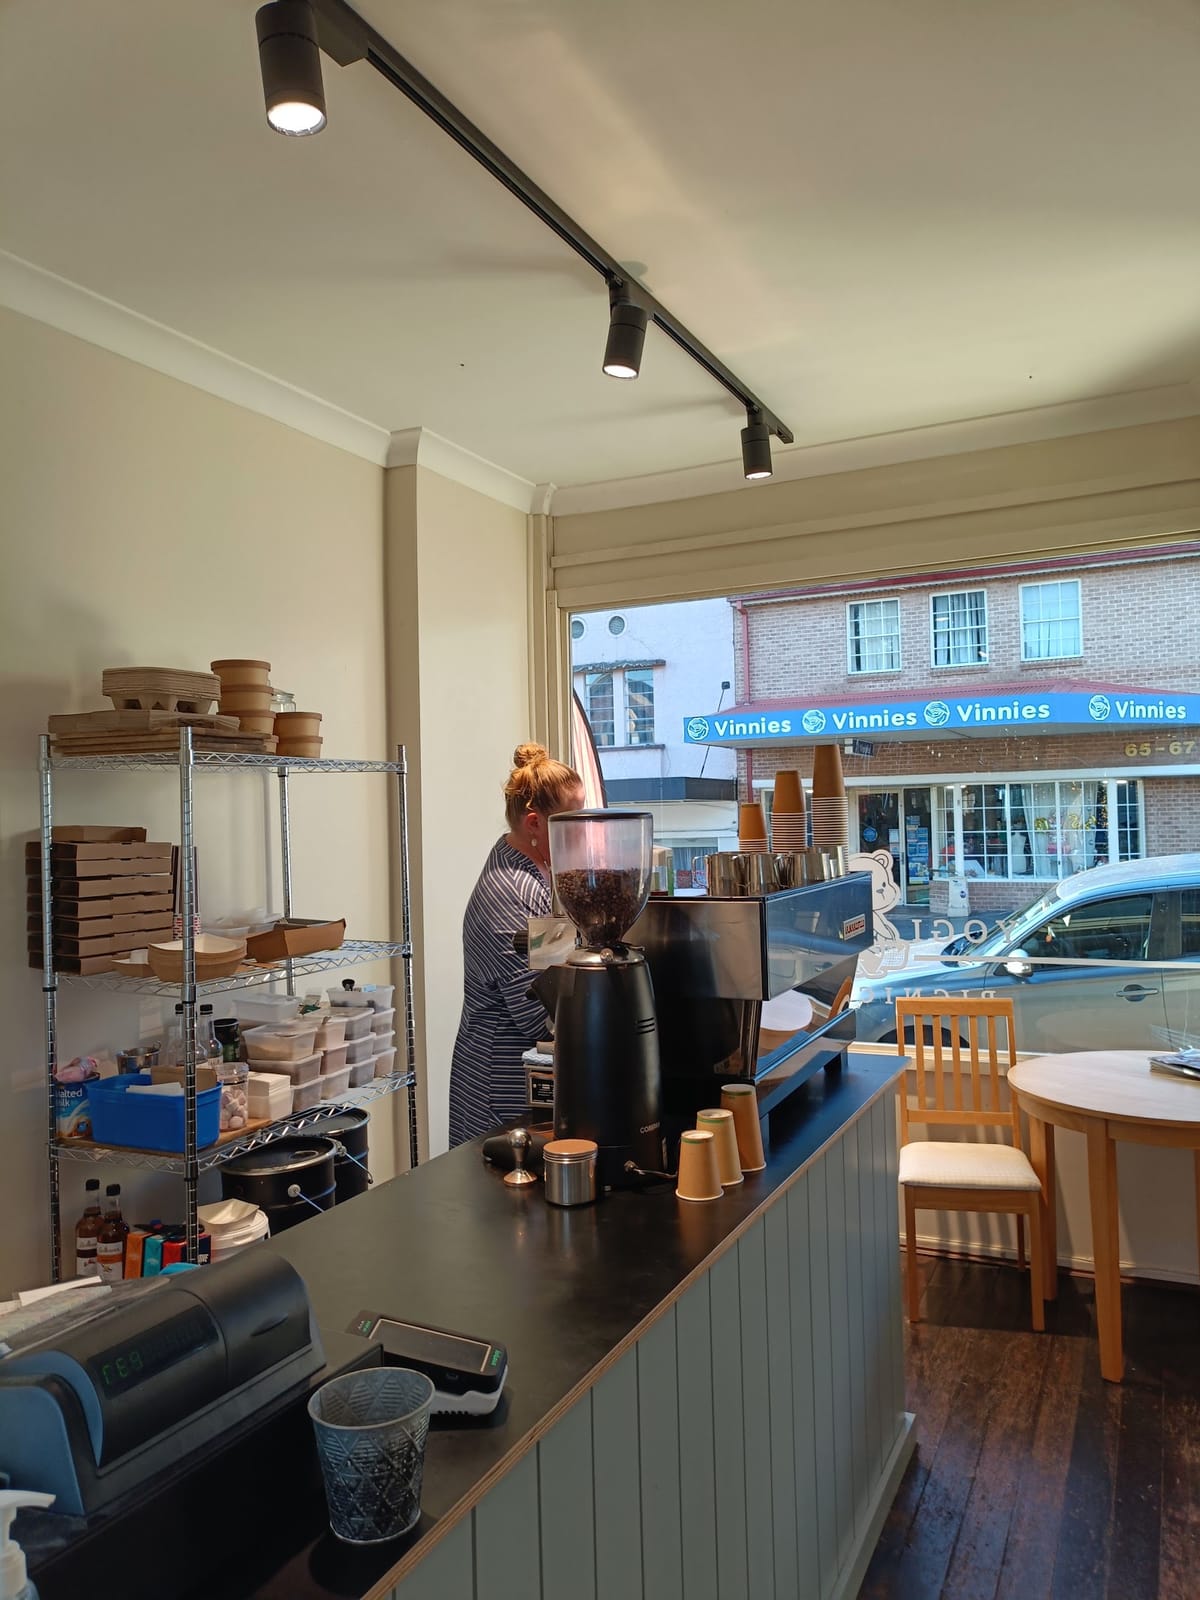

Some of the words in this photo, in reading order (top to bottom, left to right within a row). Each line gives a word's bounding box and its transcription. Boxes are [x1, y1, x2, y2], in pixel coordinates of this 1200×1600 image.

[714, 717, 792, 737] Vinnies
[832, 710, 917, 730] Vinnies
[957, 701, 1050, 722] Vinnies
[1115, 701, 1187, 719] Vinnies
